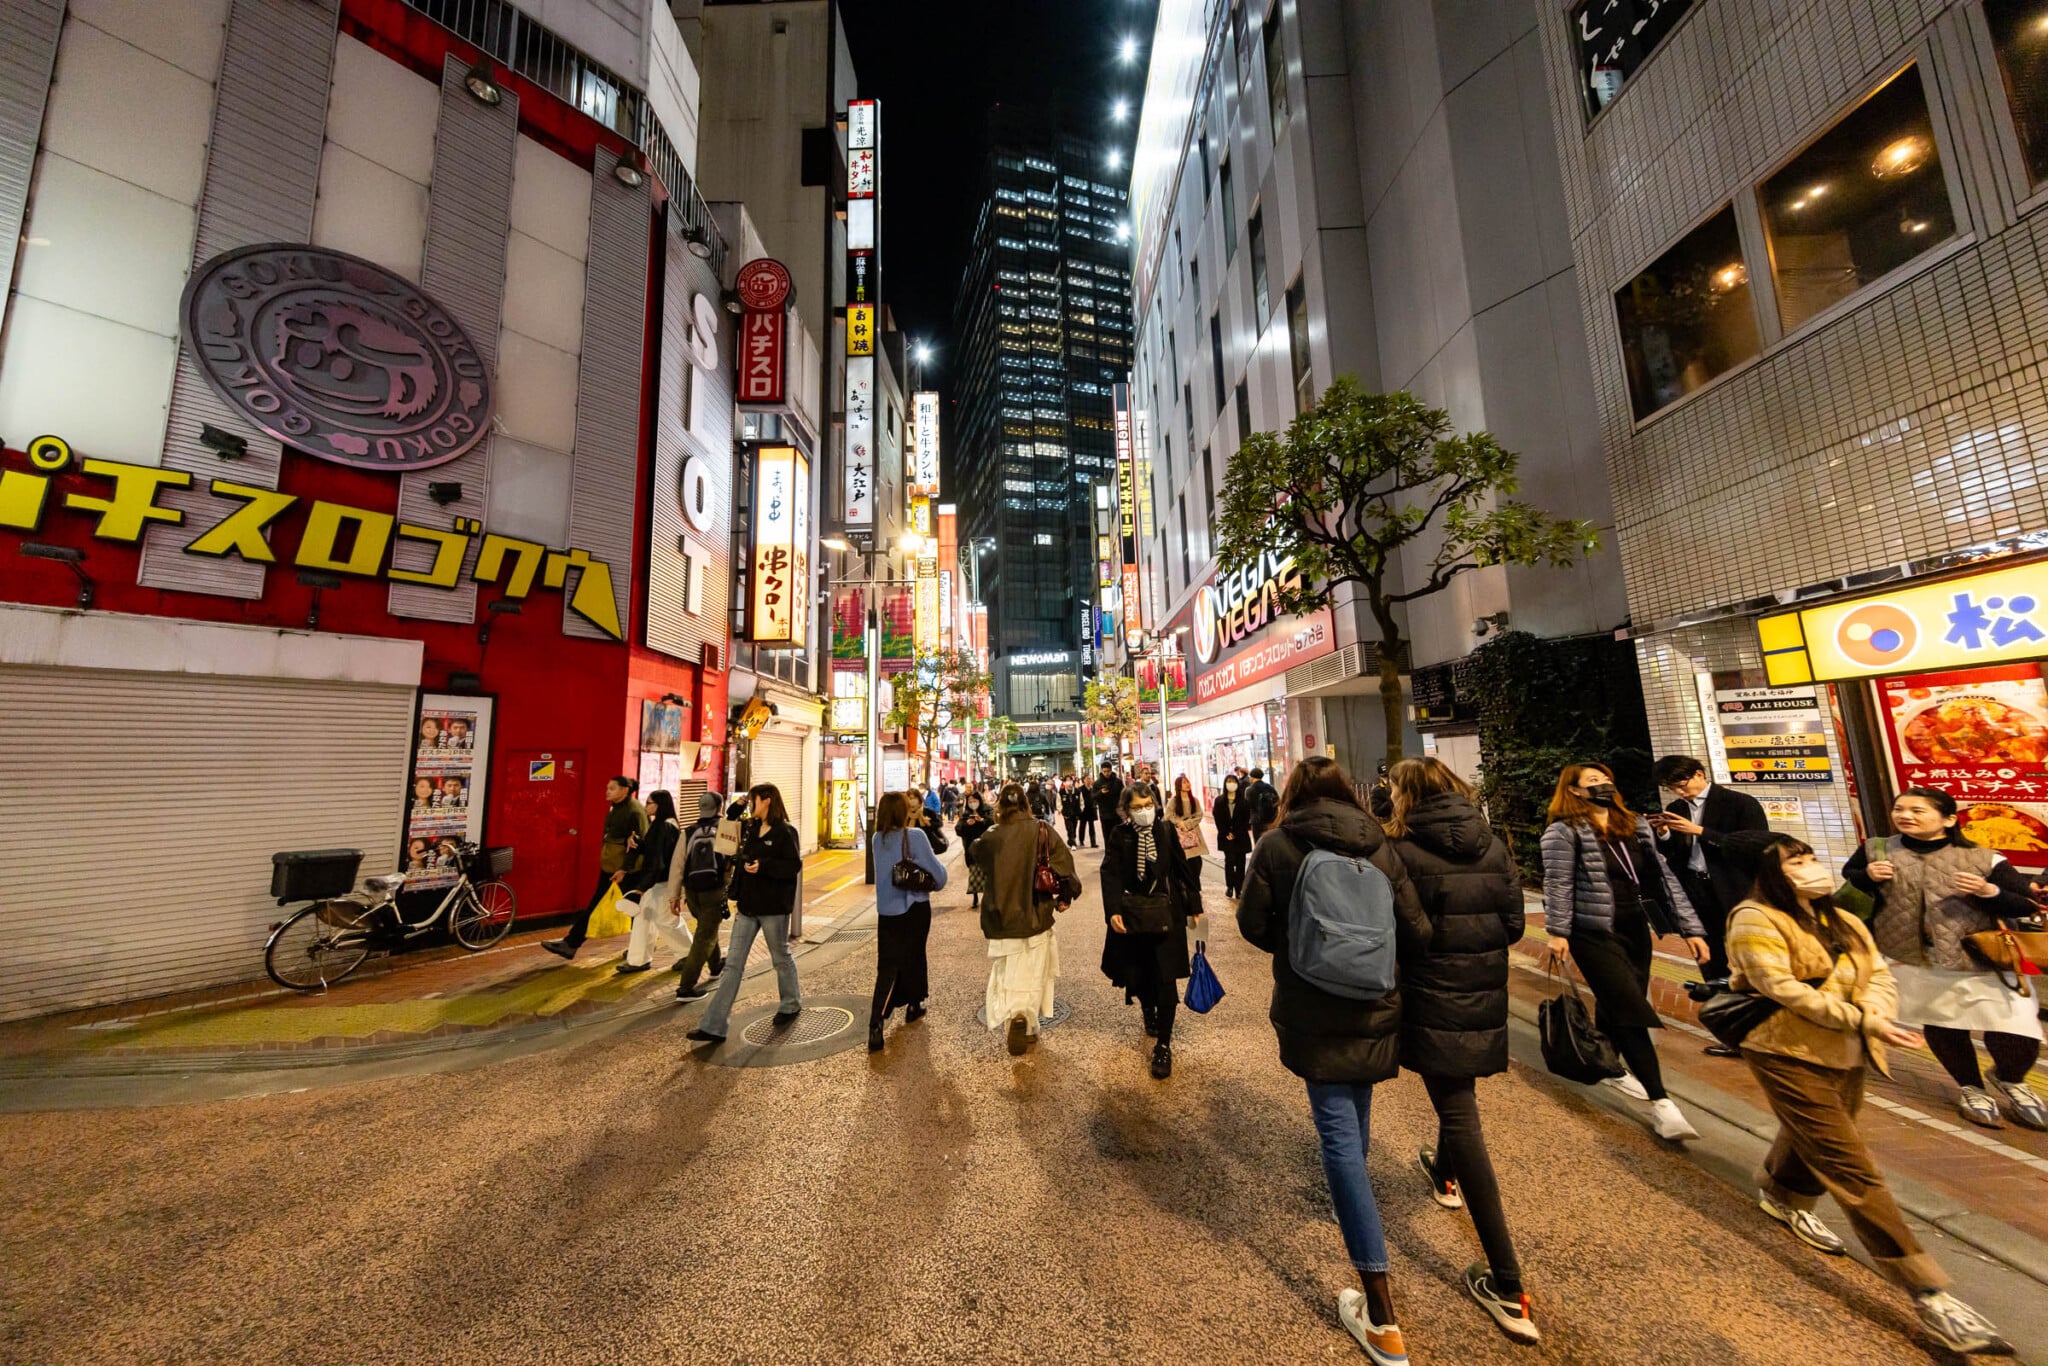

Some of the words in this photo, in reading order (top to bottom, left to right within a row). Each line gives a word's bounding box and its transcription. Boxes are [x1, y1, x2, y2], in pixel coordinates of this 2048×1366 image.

[851, 160, 860, 190] 牛タン
[222, 255, 343, 299] GOKU
[404, 299, 484, 379] GOKU
[853, 310, 869, 352] お好焼
[750, 313, 774, 397] パチスロ
[203, 341, 312, 436] GOKU
[850, 390, 868, 421] あっぱれ
[375, 411, 476, 461] GOKU
[682, 293, 719, 618] SLOT
[853, 462, 867, 503] 大江戸
[776, 617, 788, 637] 本店
[1082, 644, 1092, 666] TOWER
[1750, 701, 1772, 709] ALE
[1773, 700, 1815, 708] HOUSE
[1762, 772, 1785, 780] ALE
[1786, 771, 1829, 780] HOUSE
[1774, 760, 1806, 769] 松屋
[1906, 778, 2048, 794] トマトチキ
